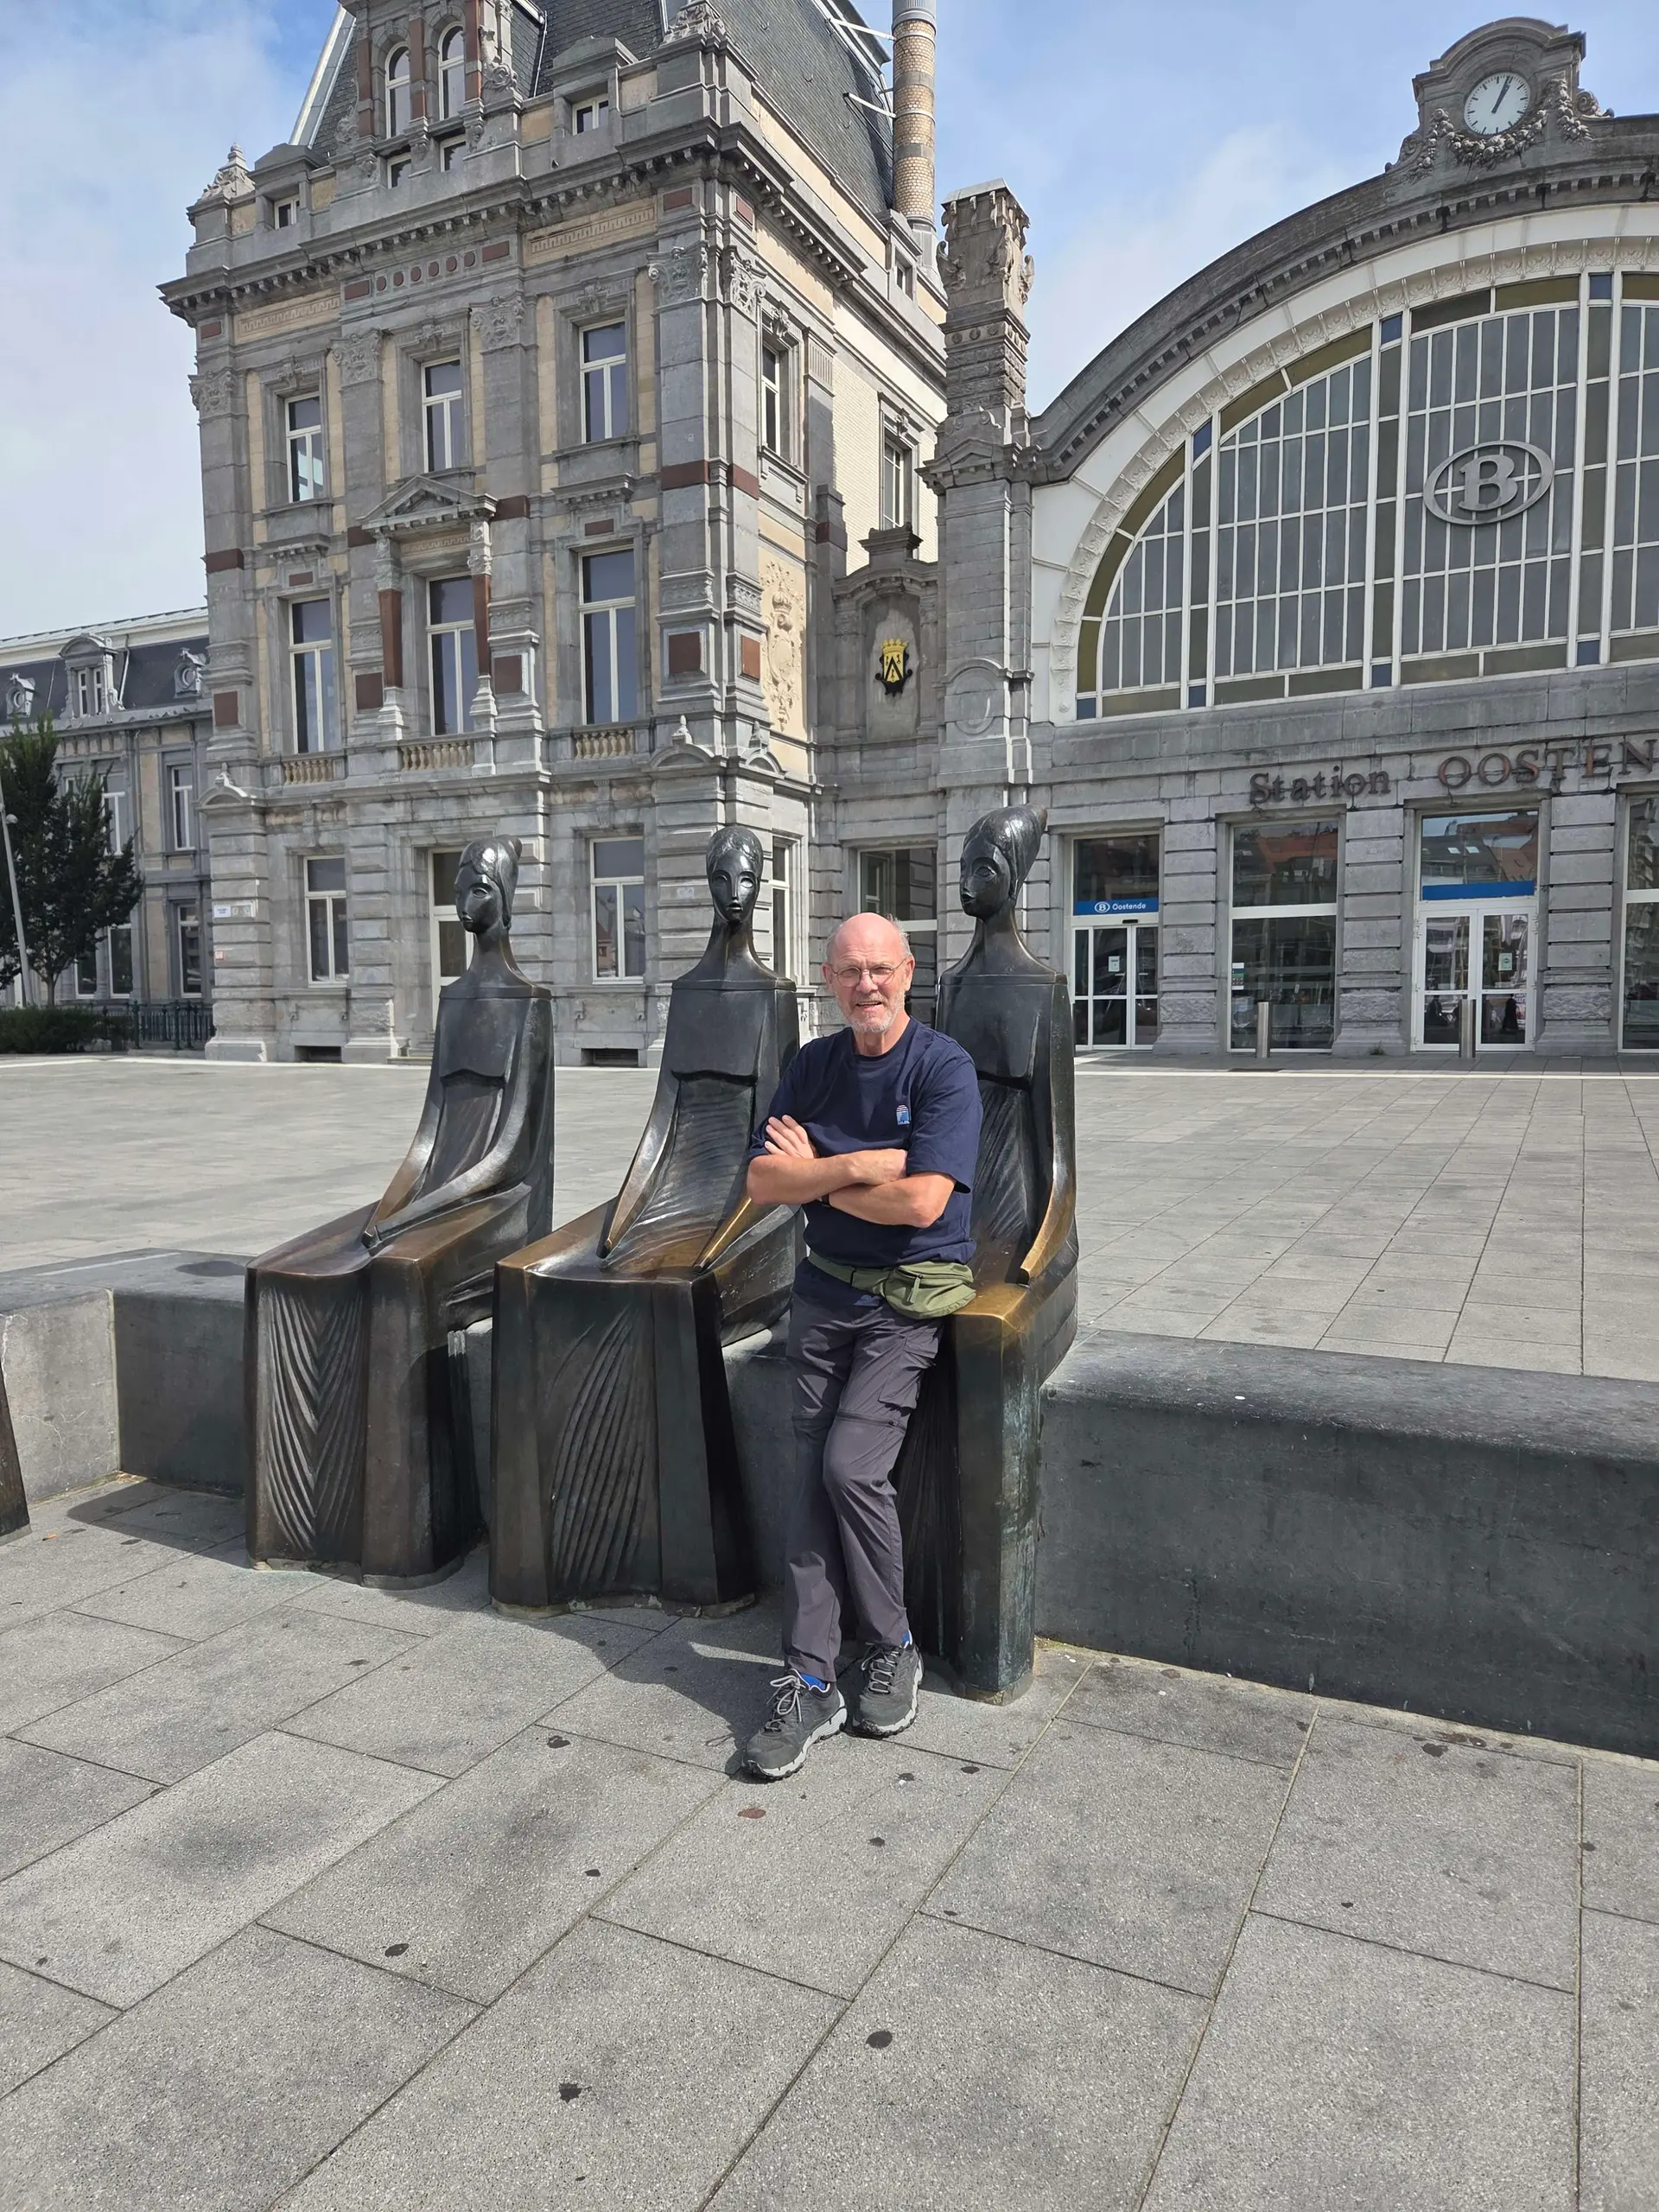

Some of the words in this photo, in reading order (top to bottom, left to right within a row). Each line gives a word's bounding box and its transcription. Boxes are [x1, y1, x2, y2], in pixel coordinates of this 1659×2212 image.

[1459, 454, 1518, 512] B
[1249, 766, 1392, 804] Station
[1438, 739, 1658, 789] OOSTEN
[1112, 902, 1147, 911] Oostende
